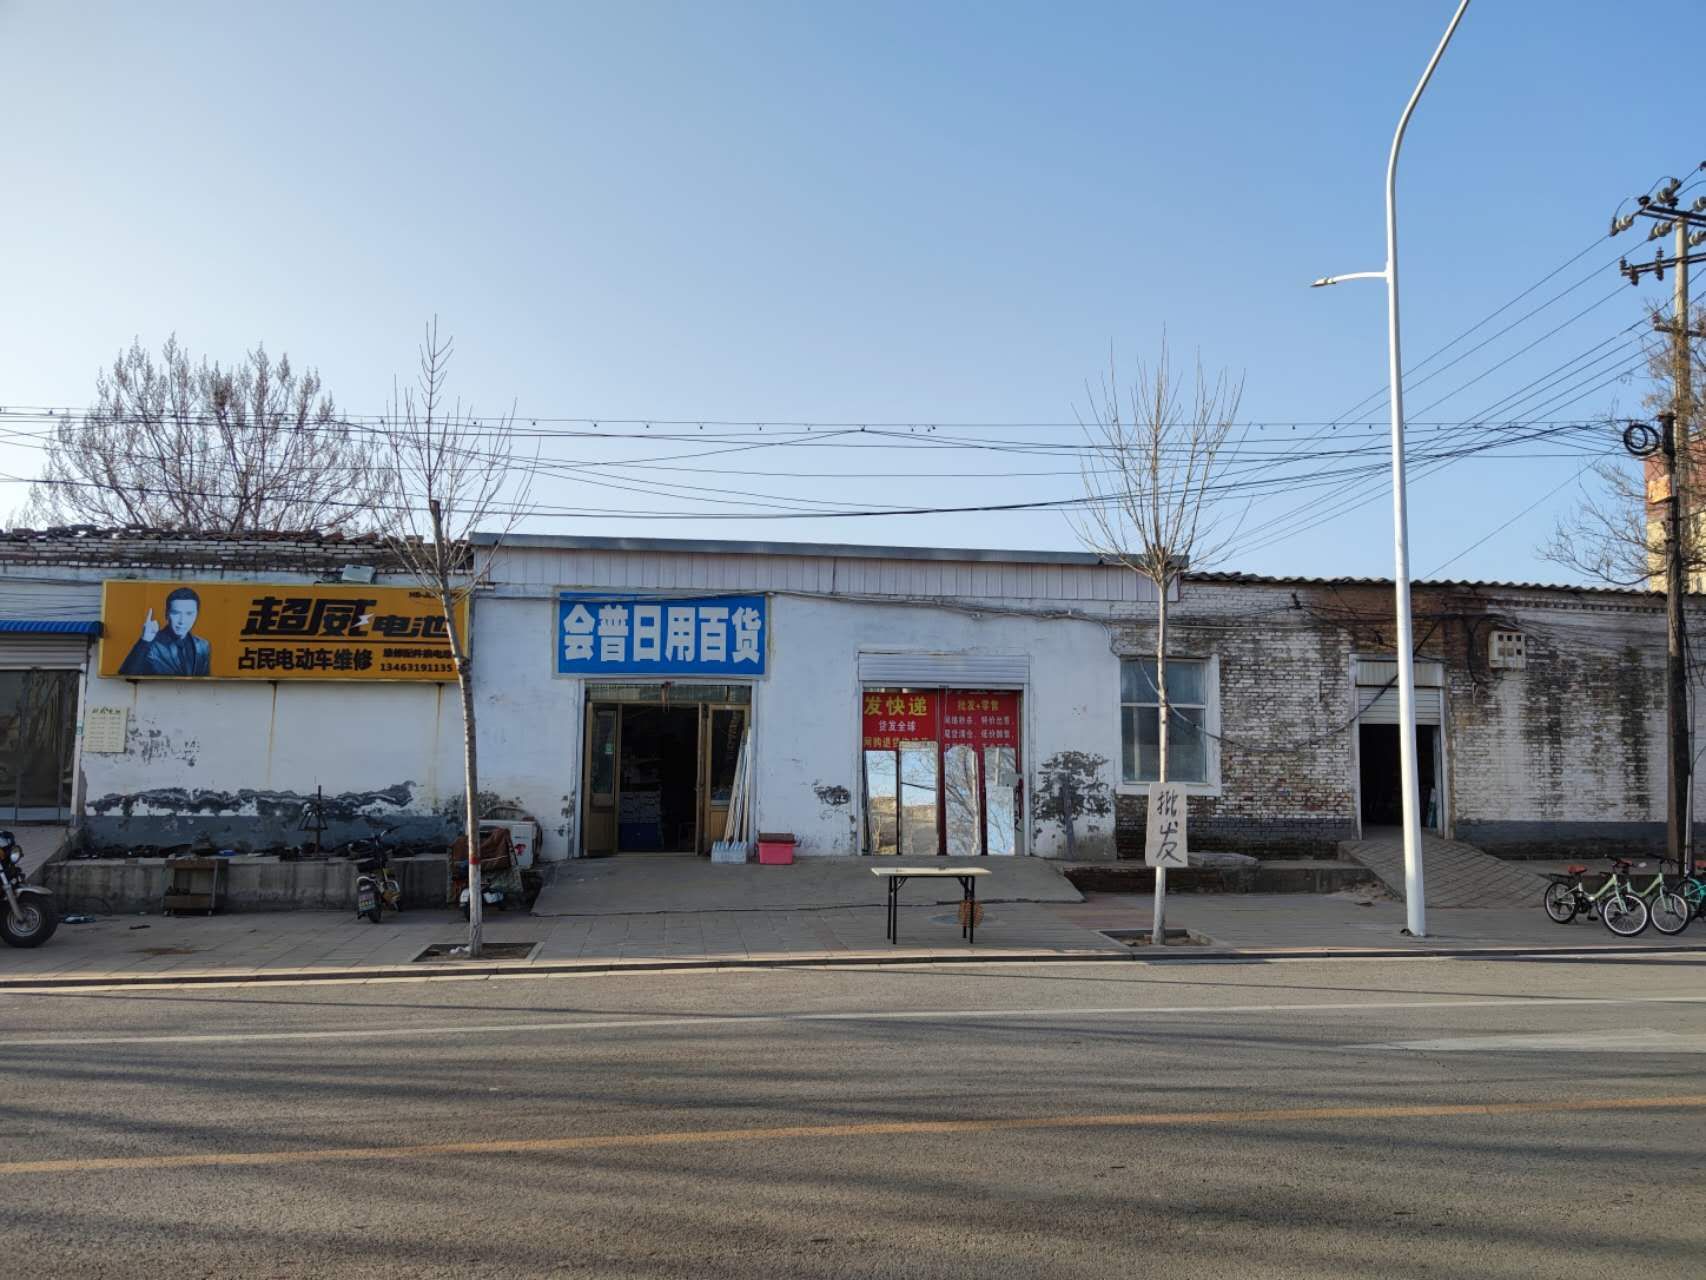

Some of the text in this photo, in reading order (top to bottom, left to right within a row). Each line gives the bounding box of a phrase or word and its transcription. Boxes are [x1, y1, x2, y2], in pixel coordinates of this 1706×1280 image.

[563, 604, 762, 664] 会普日用百货
[238, 647, 372, 671] 占民电动车维修
[864, 695, 928, 717] 发快递
[1156, 788, 1183, 863] 批发
